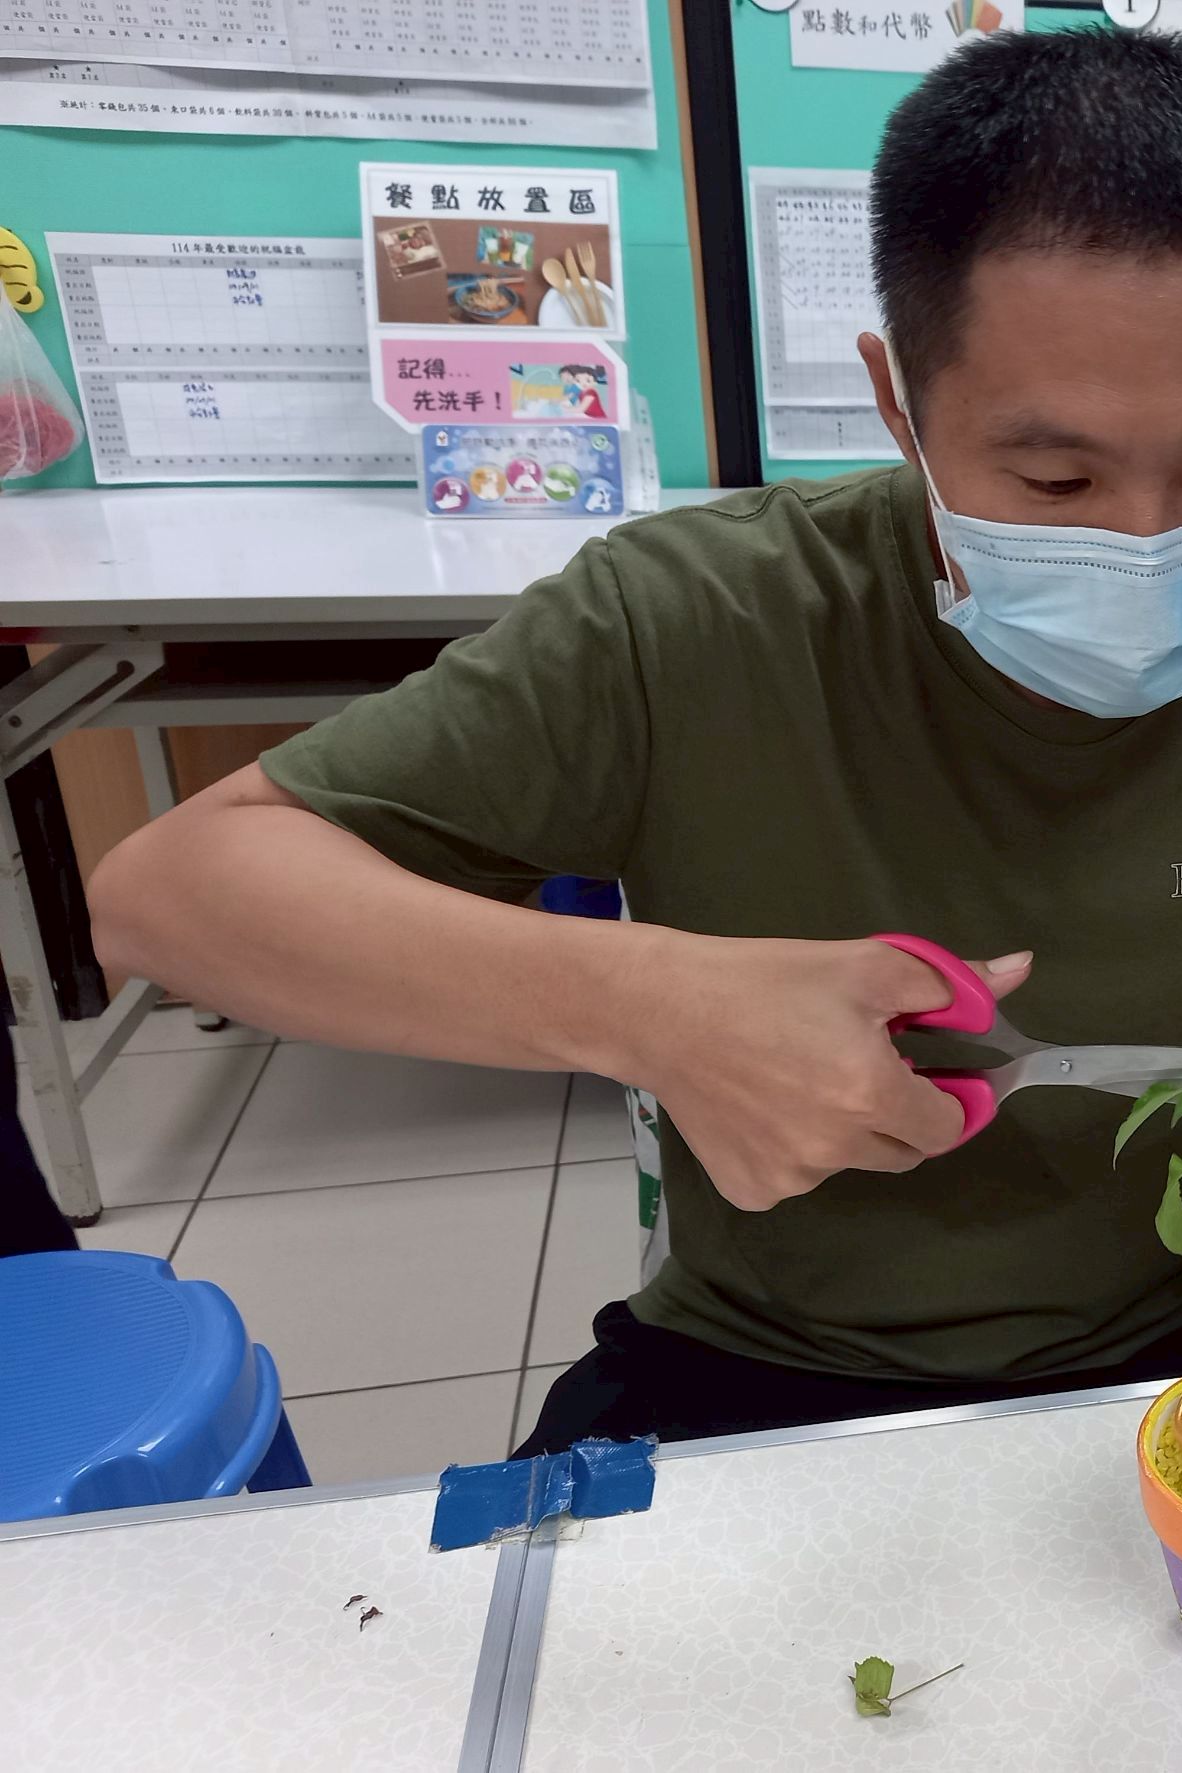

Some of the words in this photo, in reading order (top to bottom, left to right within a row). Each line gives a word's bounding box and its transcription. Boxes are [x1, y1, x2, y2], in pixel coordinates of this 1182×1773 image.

[801, 8, 933, 41] 點數和代幣
[385, 182, 596, 215] 餐點放置區
